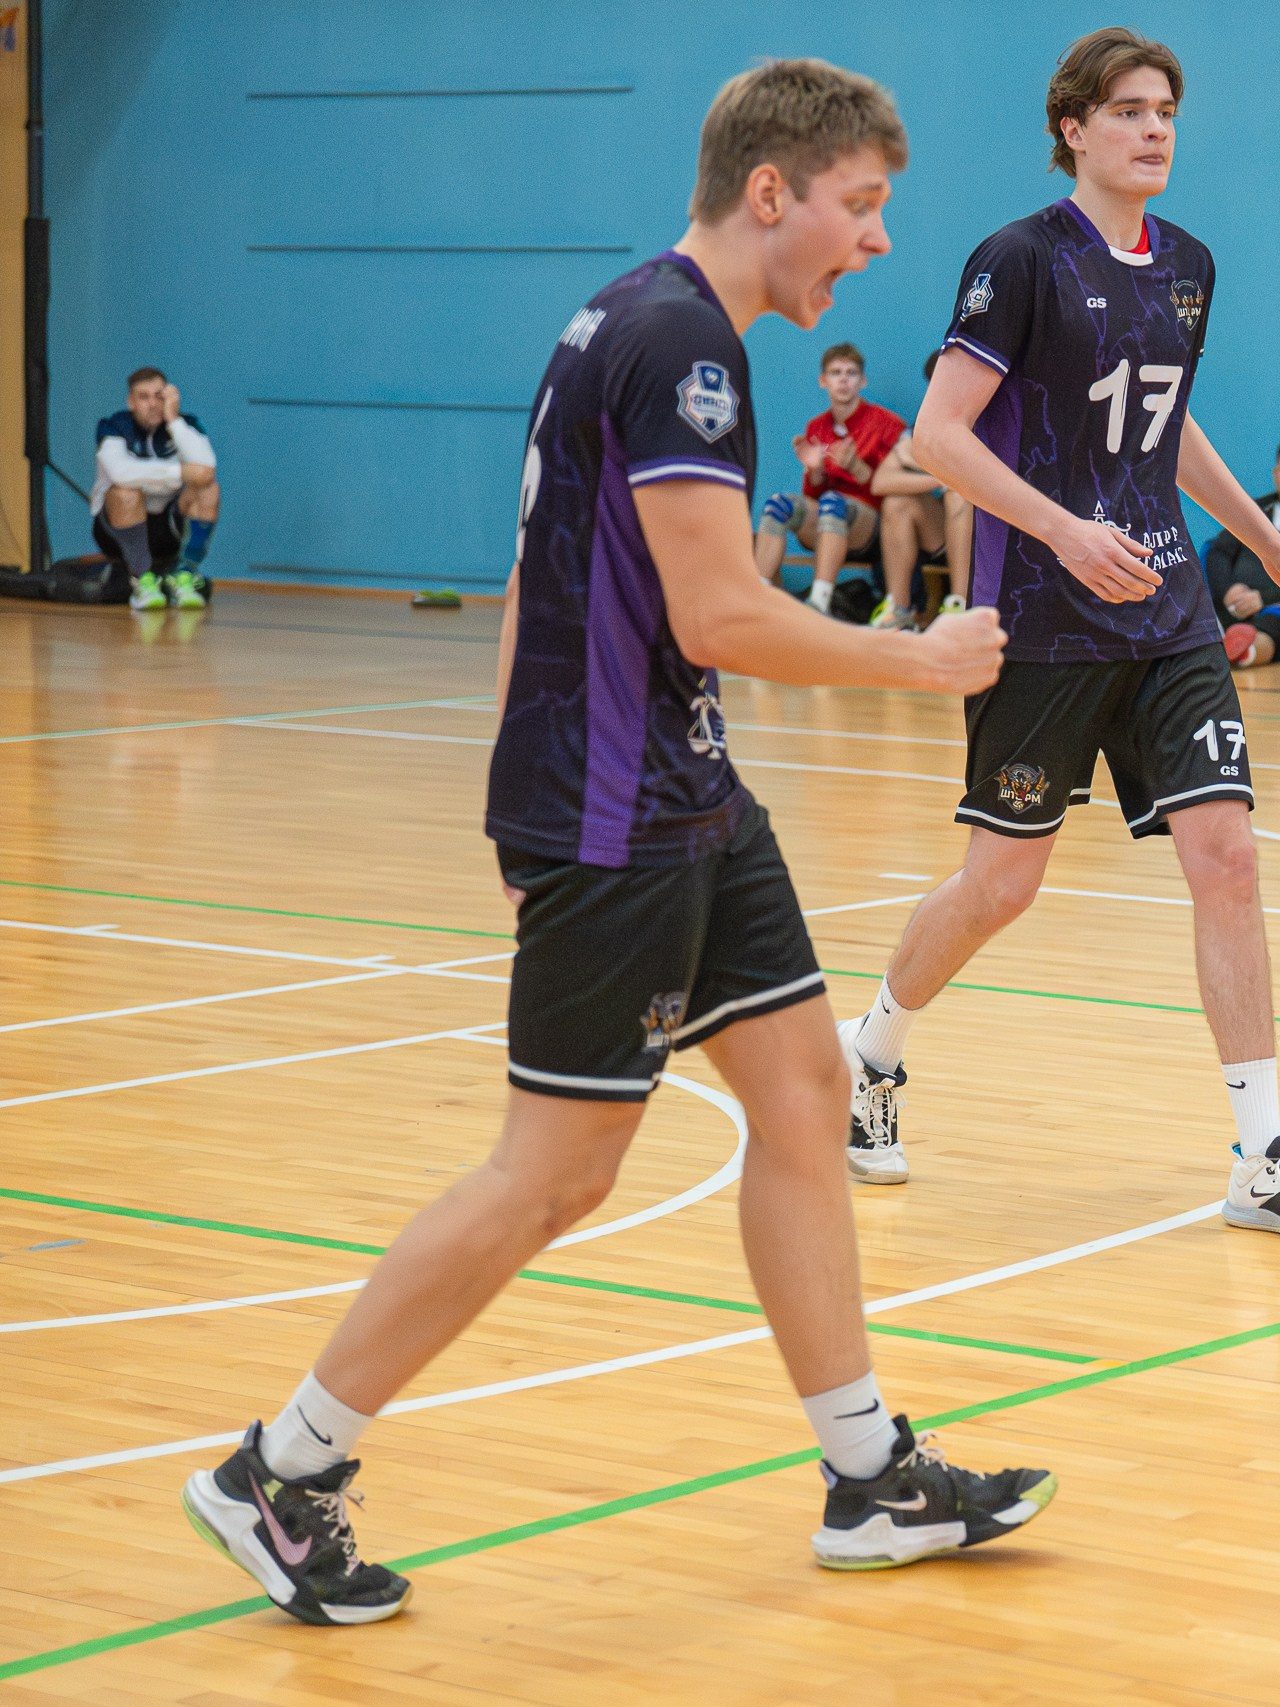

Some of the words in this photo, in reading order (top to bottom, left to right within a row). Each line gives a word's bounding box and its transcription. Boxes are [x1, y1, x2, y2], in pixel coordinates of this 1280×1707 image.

[1086, 297, 1107, 309] GS
[1088, 358, 1184, 454] 17
[1193, 719, 1246, 762] 17
[1220, 765, 1239, 777] GS
[1000, 788, 1041, 804] ШТРМ
